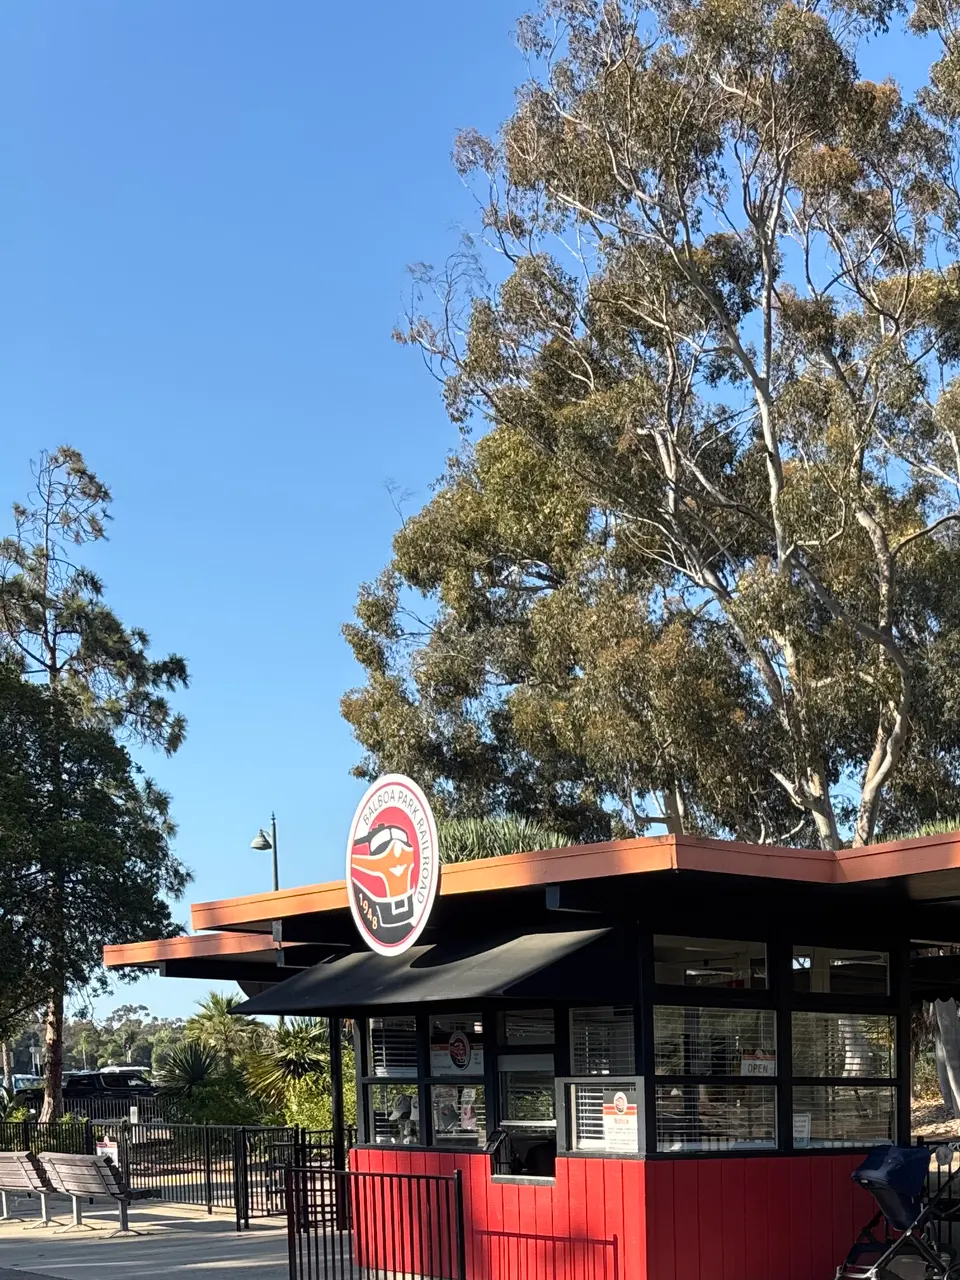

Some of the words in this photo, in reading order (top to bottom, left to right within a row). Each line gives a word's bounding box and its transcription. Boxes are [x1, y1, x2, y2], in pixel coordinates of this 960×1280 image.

[363, 789, 396, 826] BALBOA
[397, 790, 420, 820] PARK
[416, 817, 431, 904] RAILROAD
[358, 893, 379, 930] 1948
[748, 1064, 768, 1073] OPEN
